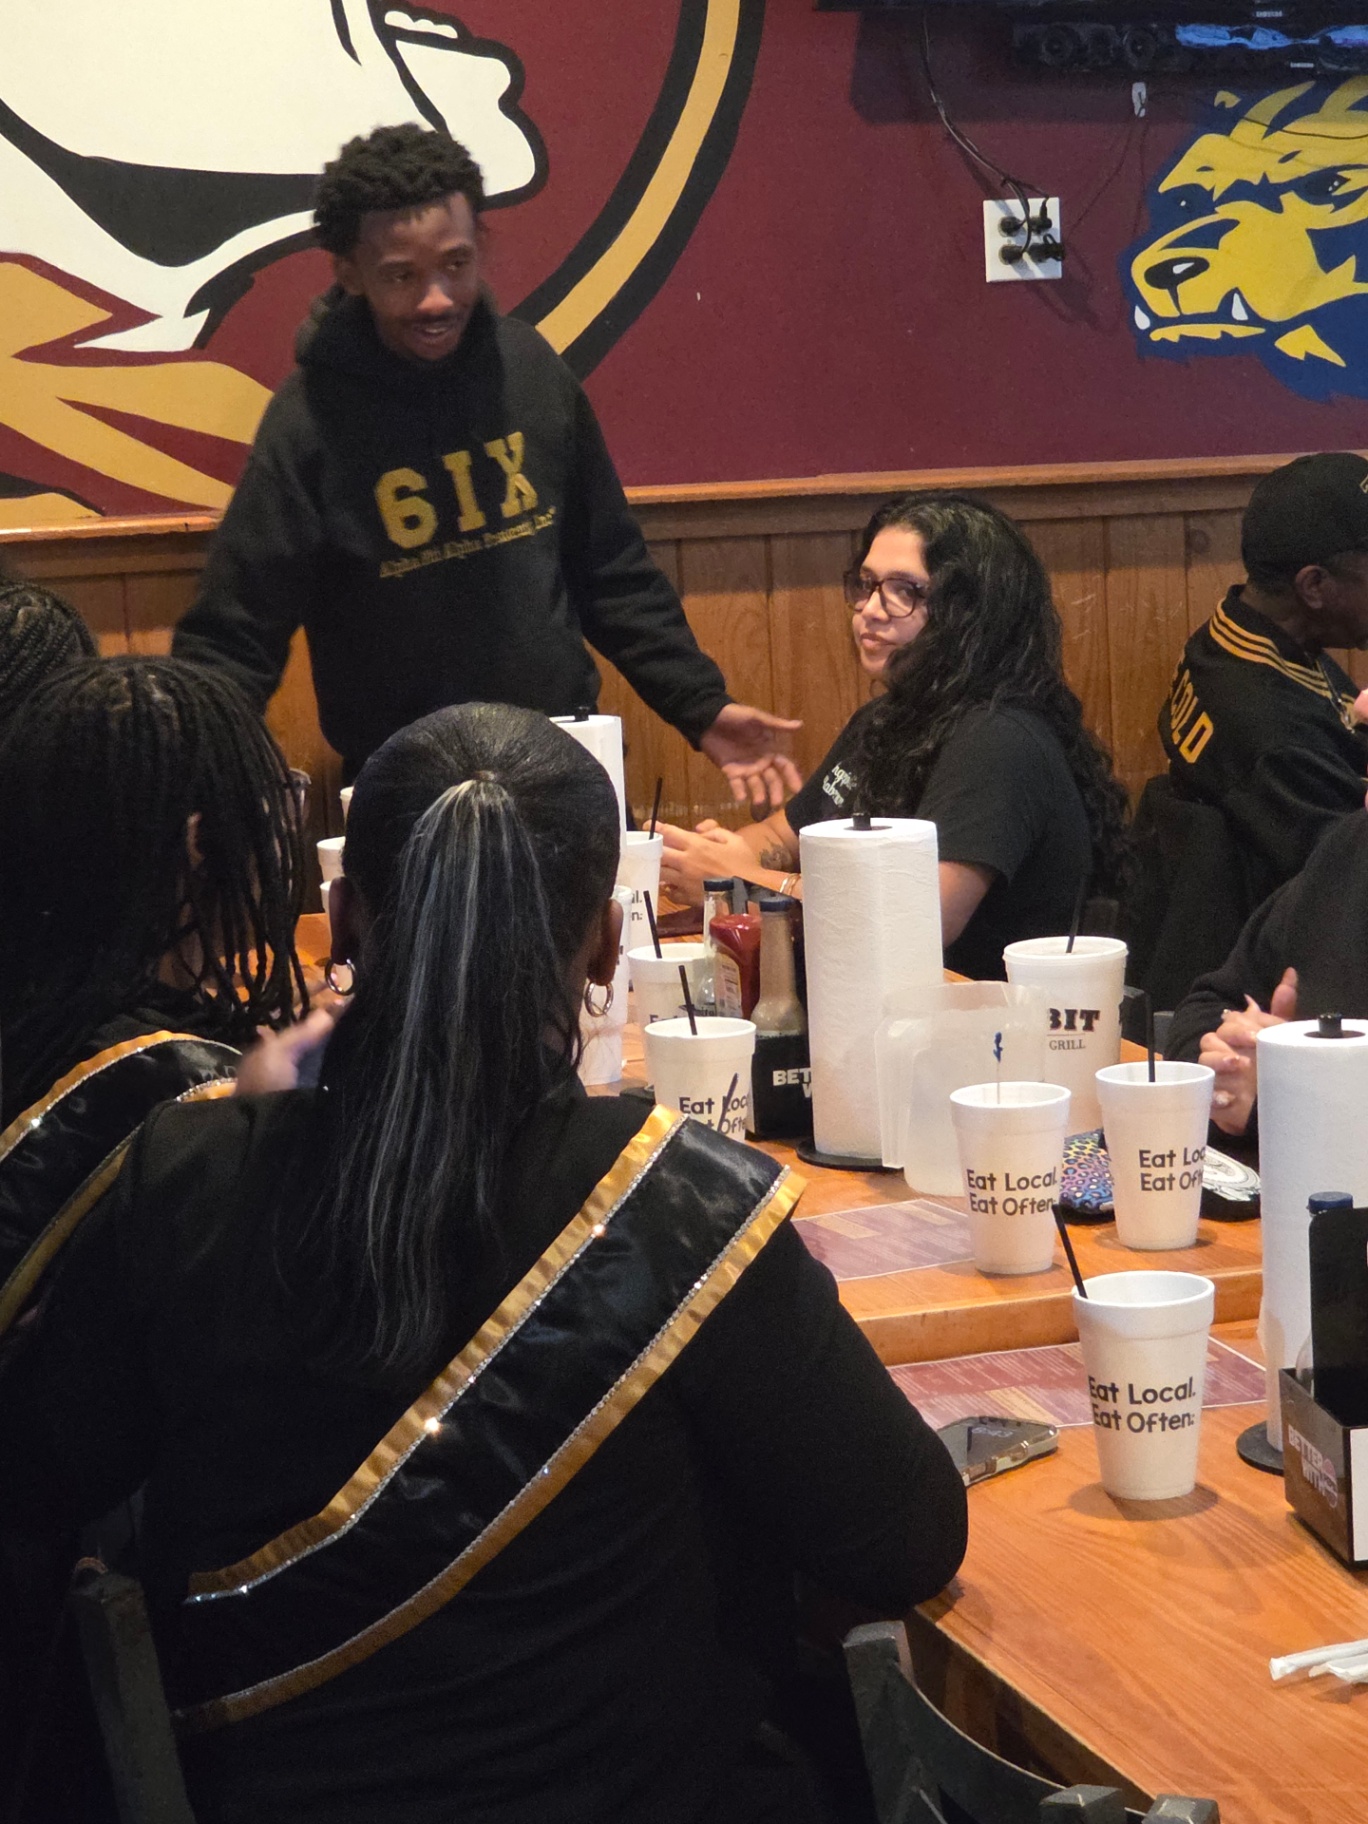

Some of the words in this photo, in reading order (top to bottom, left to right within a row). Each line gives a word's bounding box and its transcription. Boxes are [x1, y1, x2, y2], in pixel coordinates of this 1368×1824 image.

[374, 431, 538, 548] 6IX
[1049, 1039, 1086, 1051] GRILL
[679, 1096, 715, 1114] Eat
[1139, 1149, 1176, 1168] Eat
[966, 1169, 997, 1191] Eat
[1141, 1172, 1176, 1191] Eat
[969, 1191, 998, 1215] Eat
[1088, 1375, 1119, 1403] Eat
[1128, 1376, 1196, 1405] Local.
[1091, 1402, 1121, 1431] Eat
